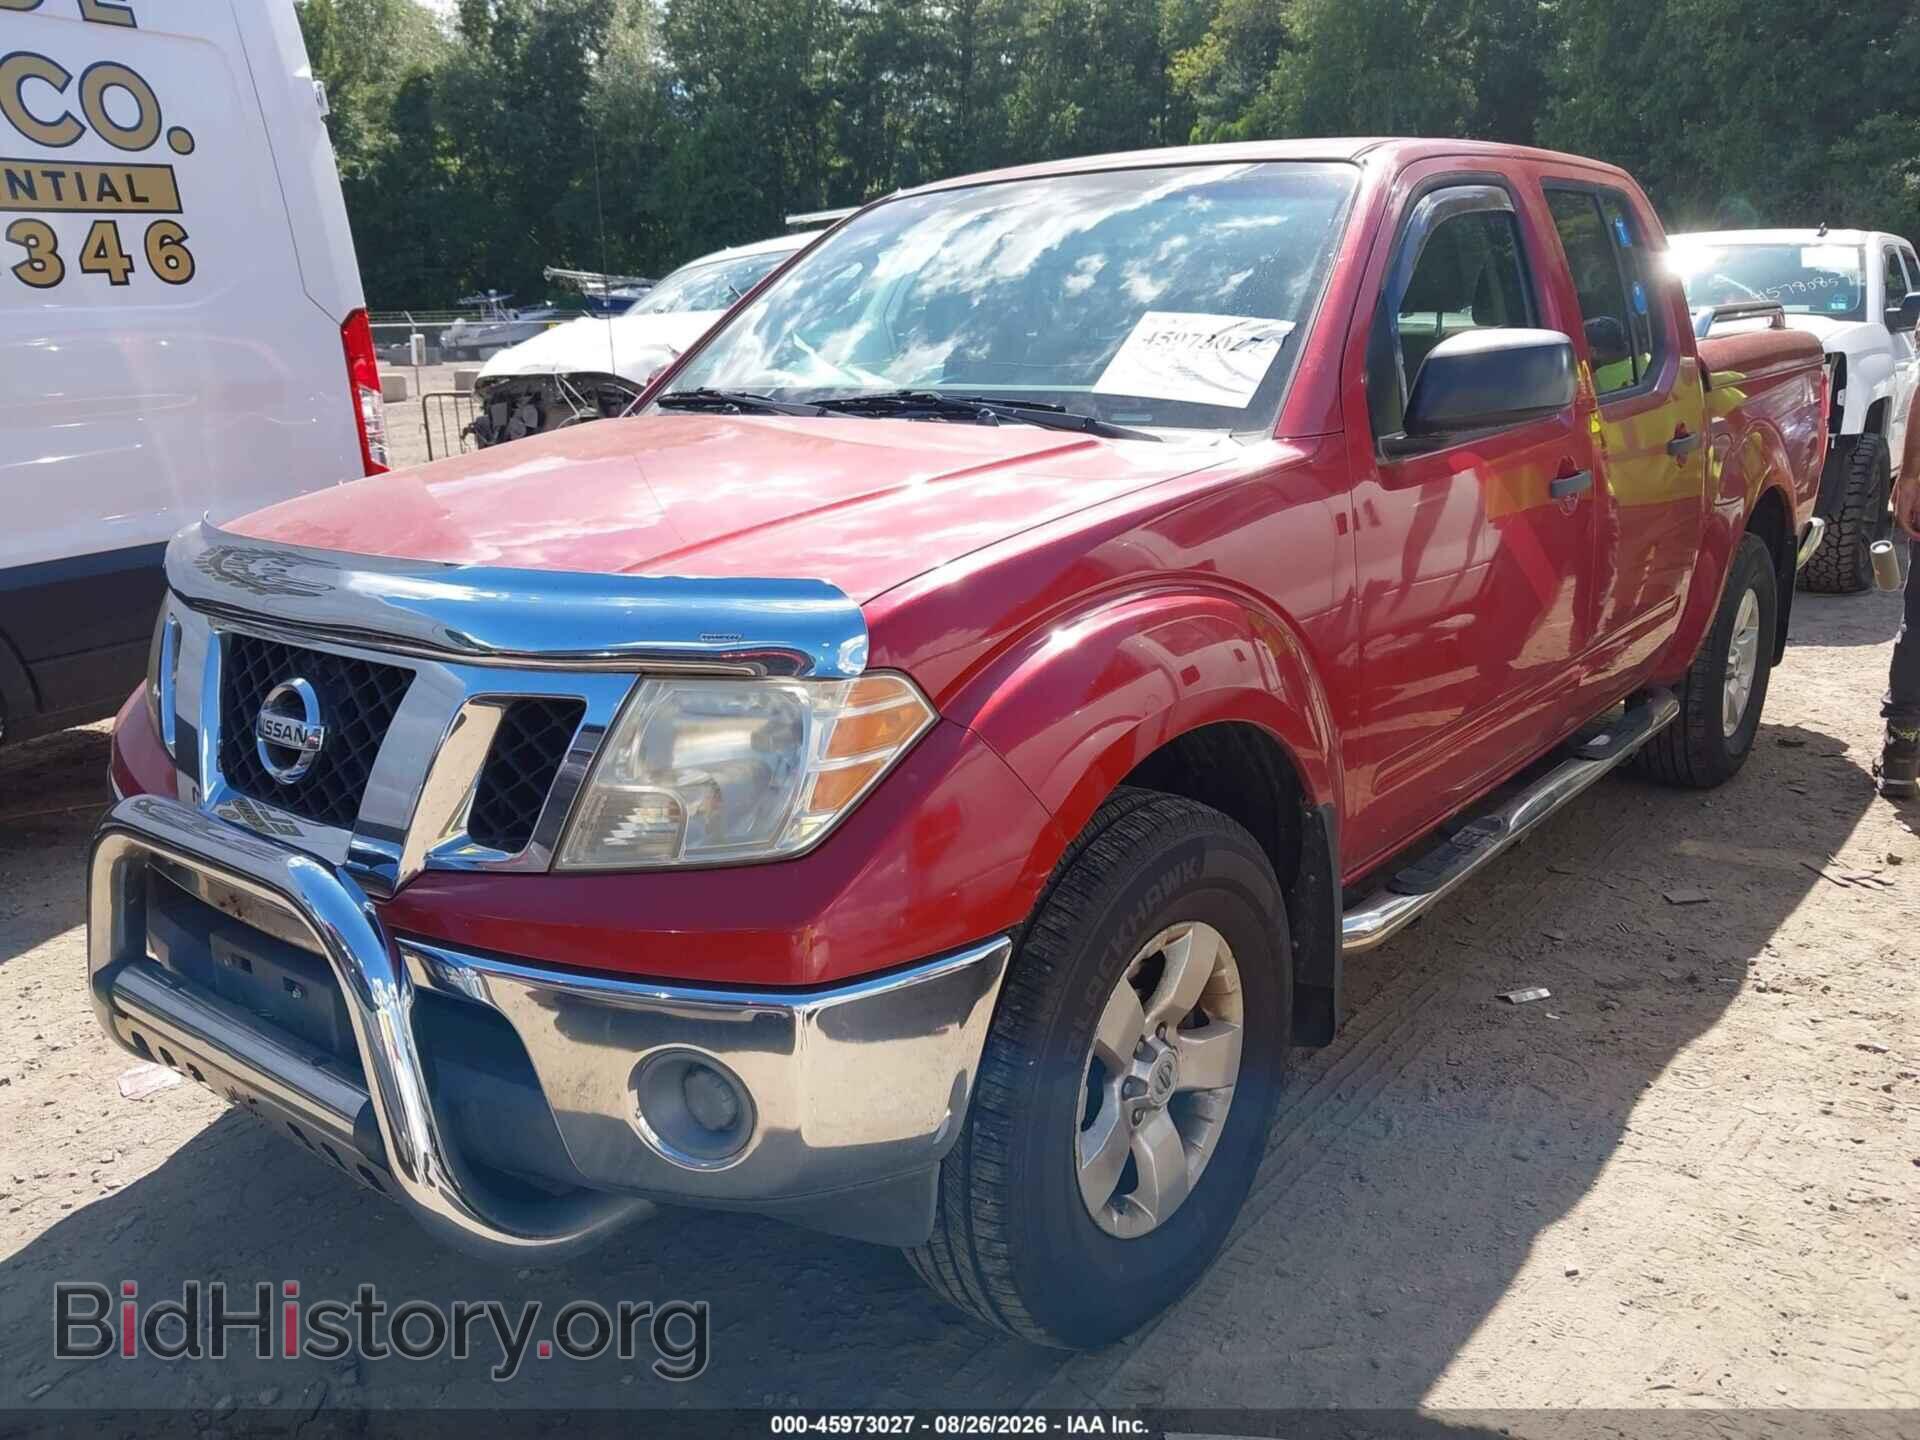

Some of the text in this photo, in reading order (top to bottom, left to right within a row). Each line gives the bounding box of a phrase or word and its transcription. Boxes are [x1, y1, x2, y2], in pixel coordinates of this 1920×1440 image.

[0, 51, 195, 155] CO.
[4, 168, 150, 204] NTIAL
[5, 217, 196, 289] 346
